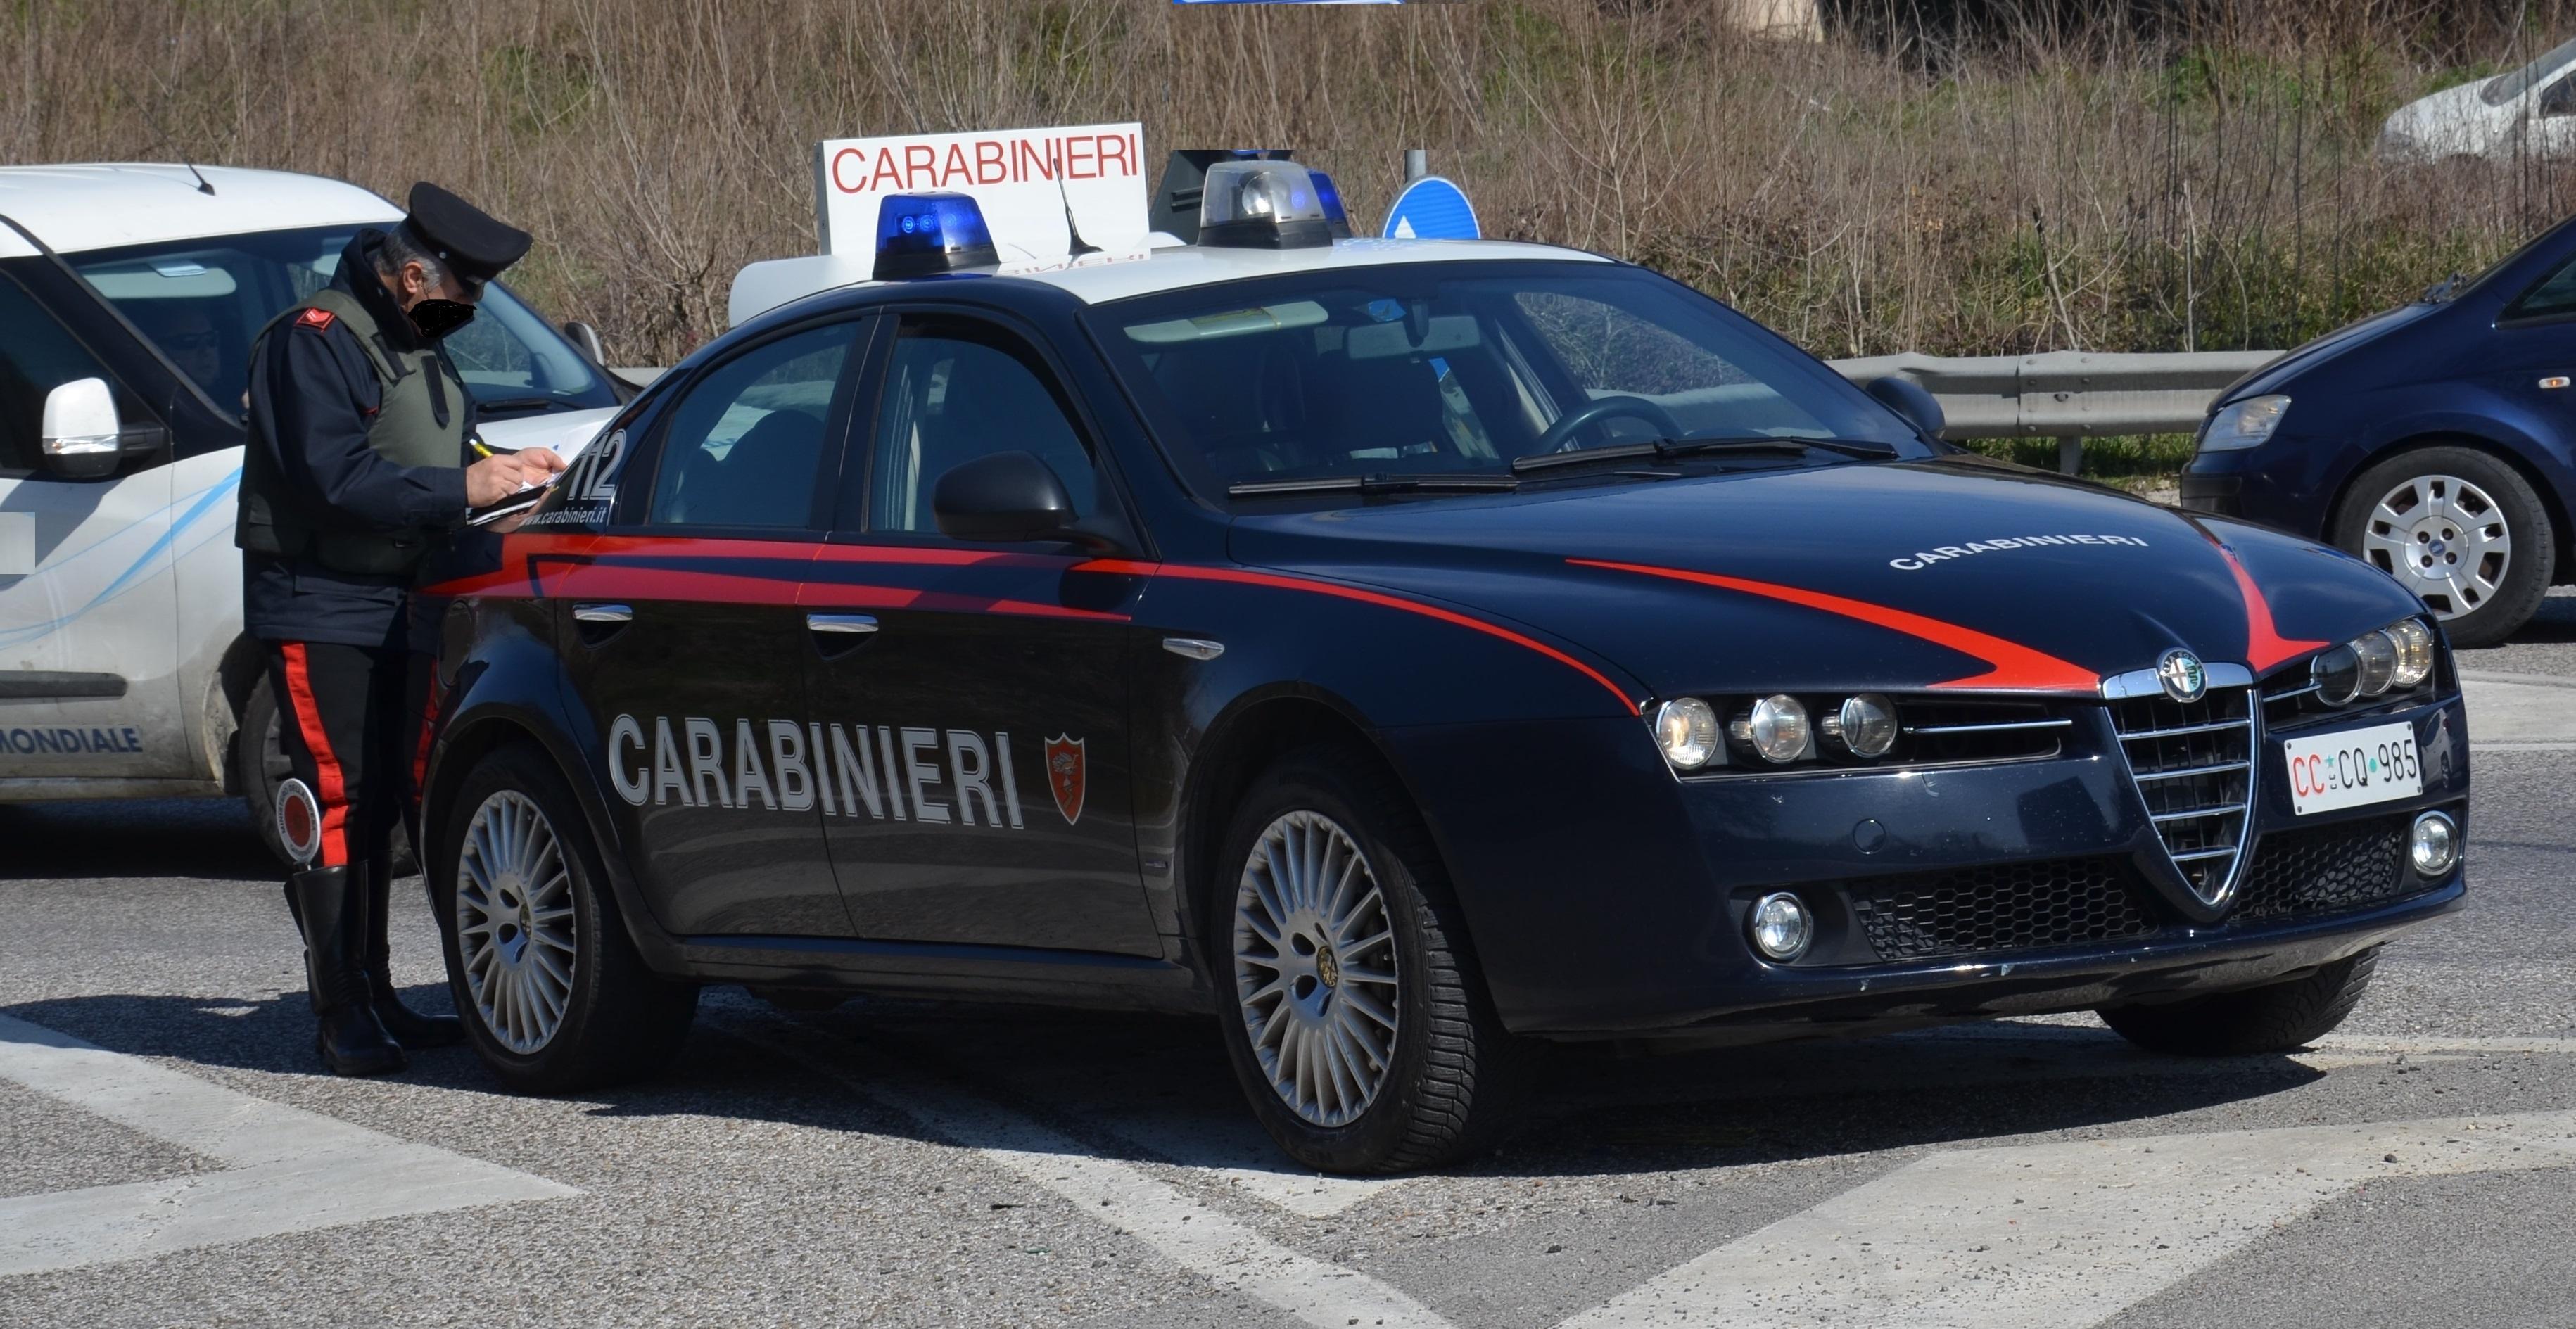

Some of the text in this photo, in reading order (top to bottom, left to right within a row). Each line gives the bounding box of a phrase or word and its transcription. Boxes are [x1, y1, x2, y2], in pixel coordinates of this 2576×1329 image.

[832, 133, 1138, 194] CARABINIERI
[566, 428, 627, 501] 112
[1889, 534, 2149, 571] CARABINIERI
[608, 713, 1024, 830] CARABINIERI
[2292, 739, 2417, 797] CC CQ 985
